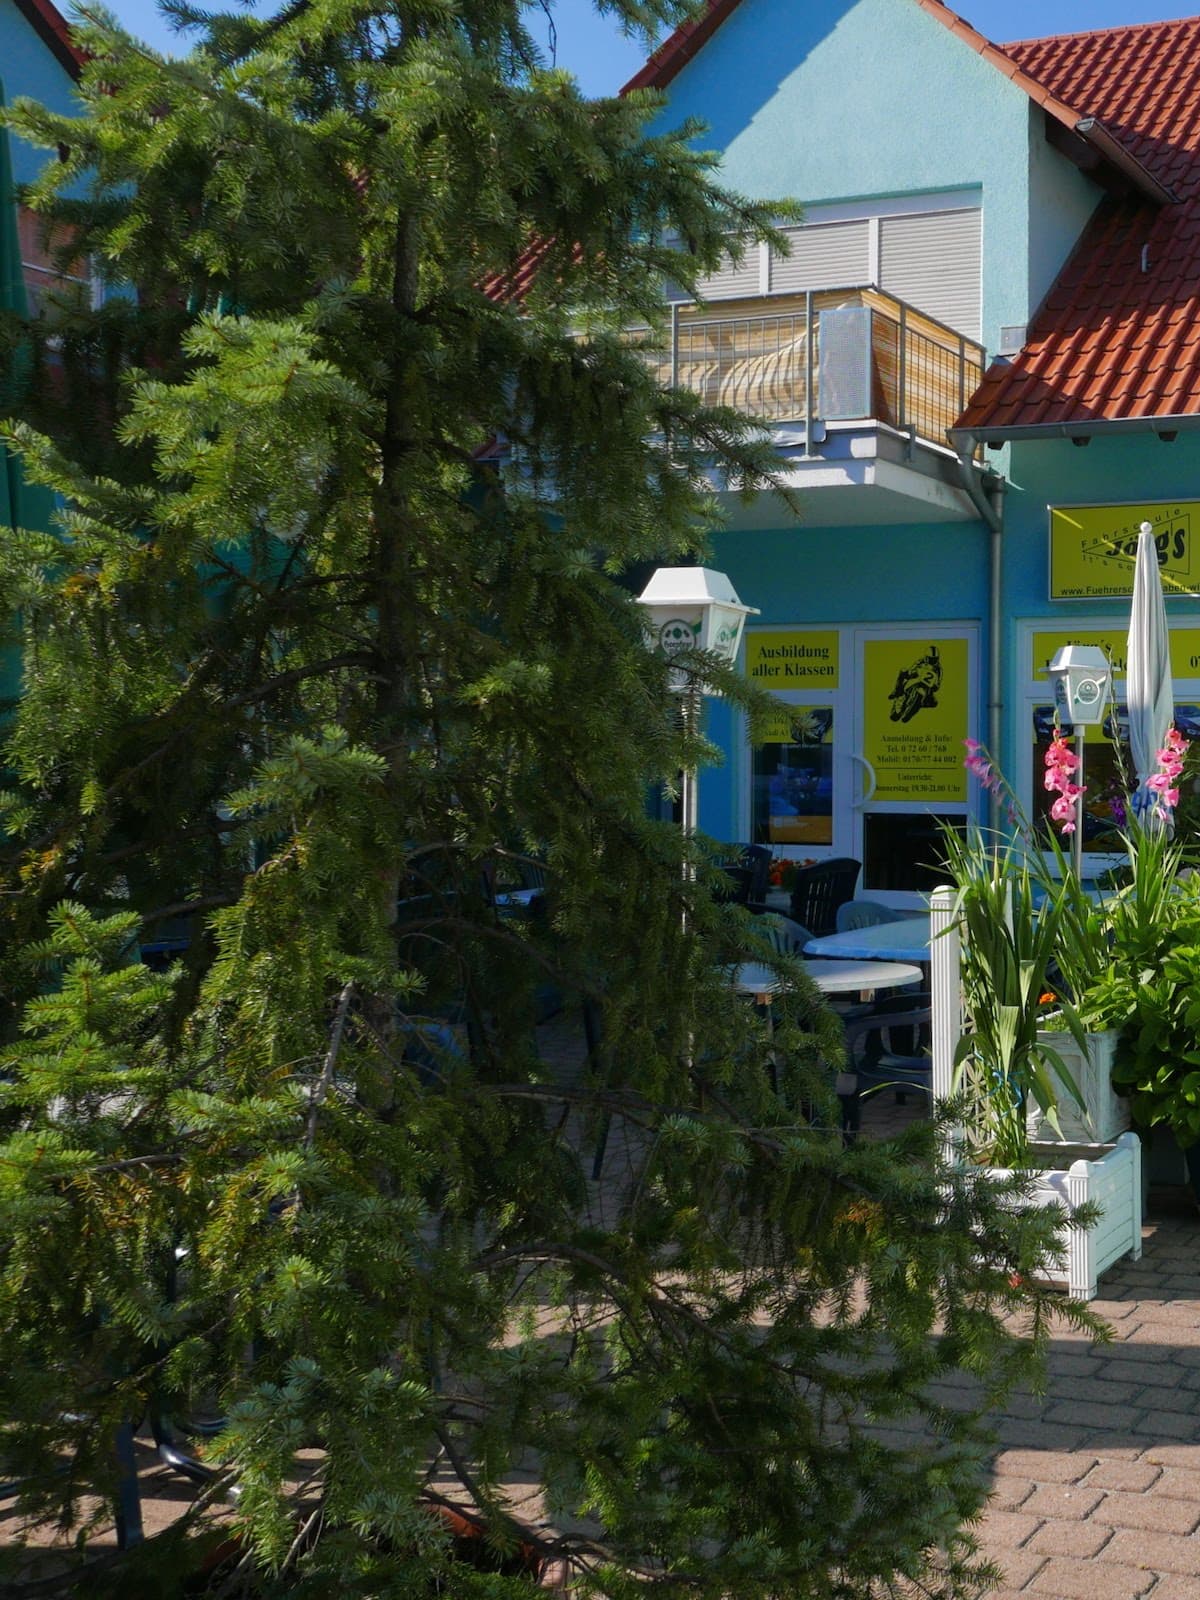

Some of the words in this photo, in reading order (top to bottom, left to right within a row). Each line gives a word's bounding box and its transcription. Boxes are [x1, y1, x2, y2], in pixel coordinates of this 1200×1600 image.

[1106, 521, 1186, 566] Jög's
[757, 644, 830, 660] Ausbildung
[751, 663, 781, 677] aller
[784, 663, 835, 677] Klassen
